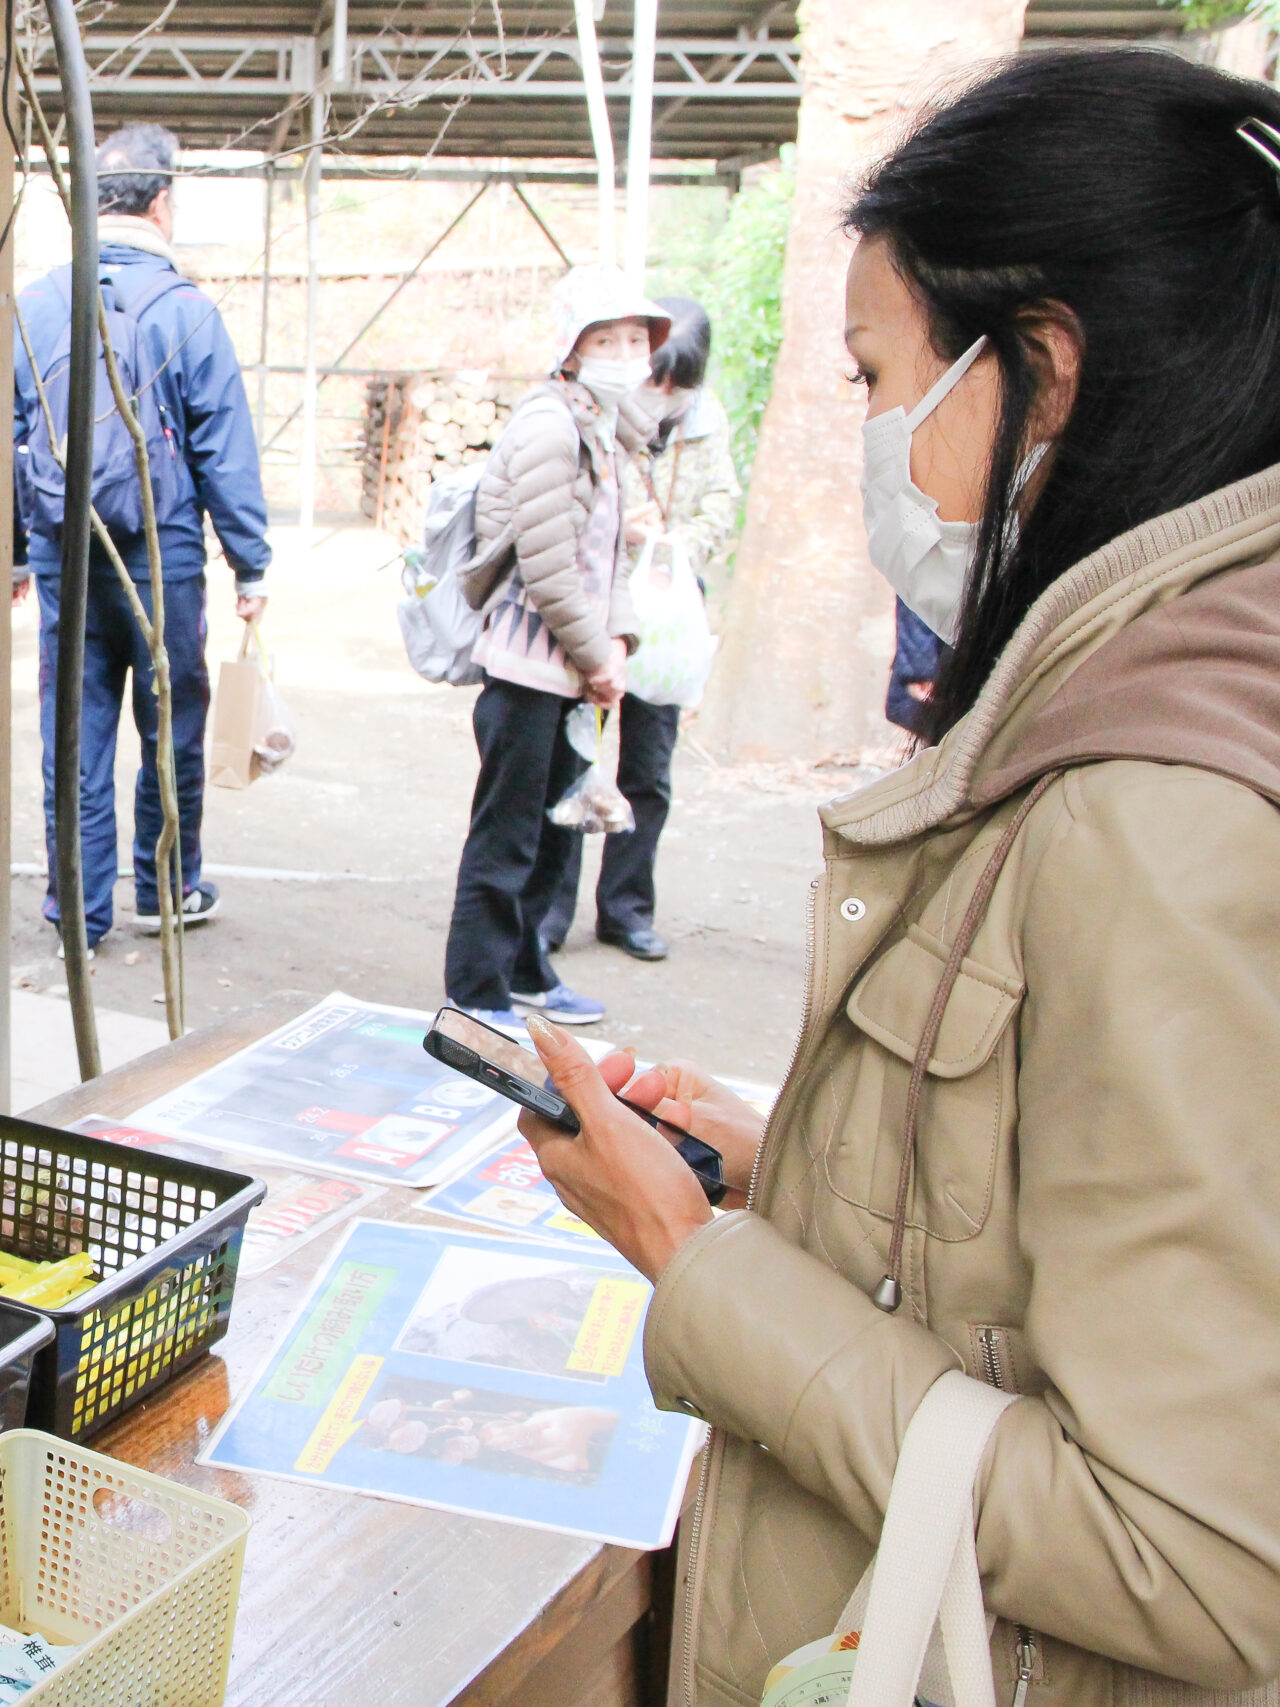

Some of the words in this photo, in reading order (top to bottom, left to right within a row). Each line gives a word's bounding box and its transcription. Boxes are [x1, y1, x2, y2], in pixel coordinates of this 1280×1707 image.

[298, 1106, 331, 1125] 24.2
[410, 1103, 461, 1120] B
[352, 1147, 408, 1166] A
[276, 1267, 379, 1403] しいたけの摘み取り方
[22, 1640, 56, 1673] 椎茸
